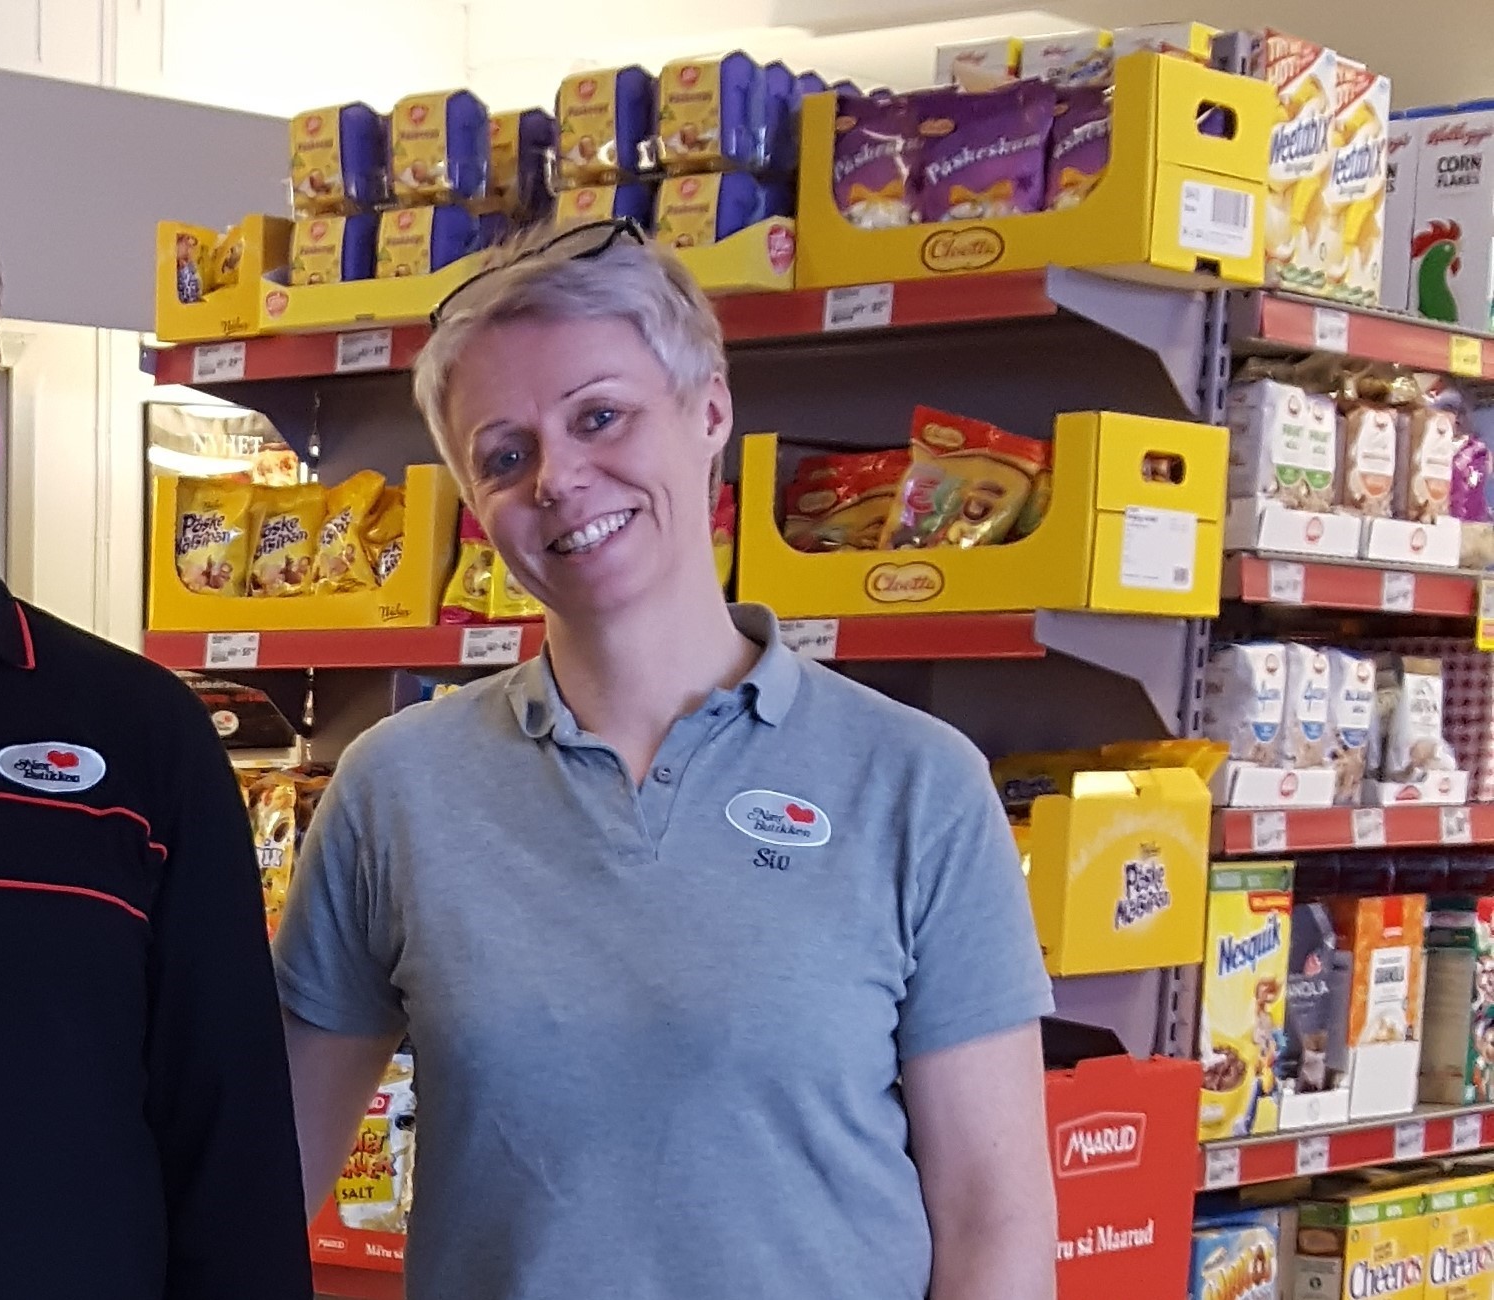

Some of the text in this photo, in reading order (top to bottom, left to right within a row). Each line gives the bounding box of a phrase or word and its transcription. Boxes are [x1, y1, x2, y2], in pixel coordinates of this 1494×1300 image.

[1270, 115, 1334, 165] Weetabix
[1333, 138, 1386, 184] eetabix
[1437, 153, 1482, 174] CORN
[191, 431, 264, 457] NYHET
[261, 516, 300, 538] åske
[1218, 914, 1281, 977] Nesquik
[1063, 1125, 1137, 1166] MAARUD
[342, 1186, 375, 1199] SALT
[1096, 1217, 1155, 1253] Maarud
